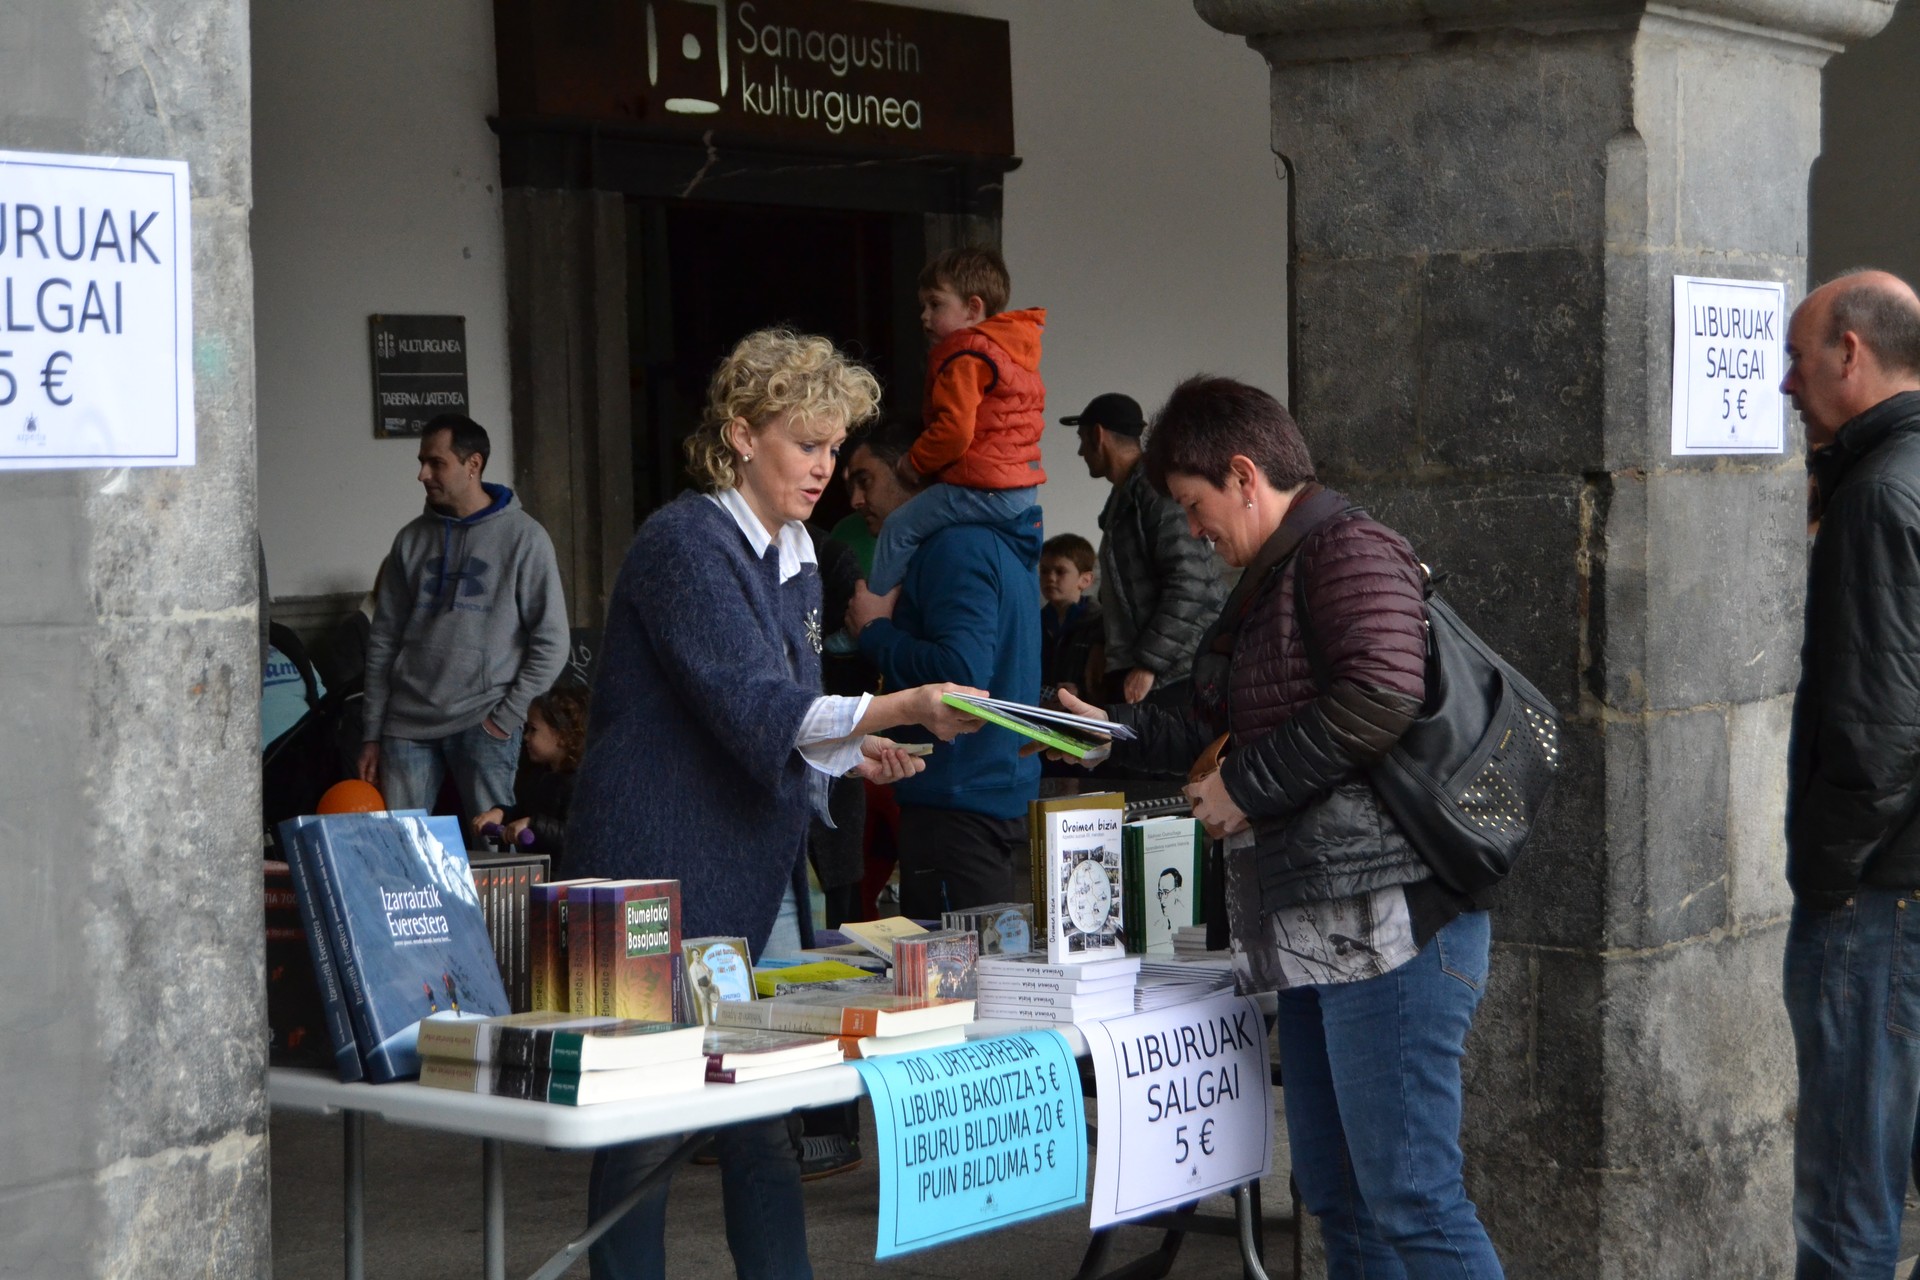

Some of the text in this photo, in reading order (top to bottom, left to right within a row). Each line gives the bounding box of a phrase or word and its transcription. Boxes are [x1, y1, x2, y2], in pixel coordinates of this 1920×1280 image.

[737, 2, 920, 76] Sanagustin
[742, 61, 921, 133] kulturgunea
[0, 203, 161, 264] RUAK
[0, 277, 122, 334] LGAI
[1693, 305, 1774, 341] LIBURUAK
[399, 339, 461, 353] KULTURGUNEA
[1706, 347, 1765, 380] SALGAI
[40, 350, 73, 406] €
[381, 392, 419, 405] TABERNA
[1722, 388, 1748, 419] 5 €
[1062, 817, 1118, 833] Oroimen bizia
[380, 884, 442, 910] Izarraiztik
[627, 904, 668, 925] Etumetako
[313, 920, 328, 962] Everestera
[386, 912, 449, 936] Everestera
[628, 930, 669, 950] Basajauna
[321, 961, 338, 1002] Izarraiztik
[1026, 967, 1064, 977] Oroimen bizia
[1038, 983, 1059, 991] Oroimen
[1019, 1010, 1056, 1019] Oroimen bizia
[1033, 997, 1054, 1005] Oroimen
[897, 1036, 1040, 1085] 700. URTEURRENA
[1121, 1011, 1253, 1078] LIBURUAK
[901, 1062, 1060, 1127] LIBURU BAKOITZA 5 €
[1147, 1063, 1240, 1122] SALGAI
[904, 1099, 1066, 1167] LIBURU BILDUMA 20 €
[1175, 1118, 1215, 1164] 5 €
[918, 1139, 1056, 1203] IPUIN BILDUMA 5 €
